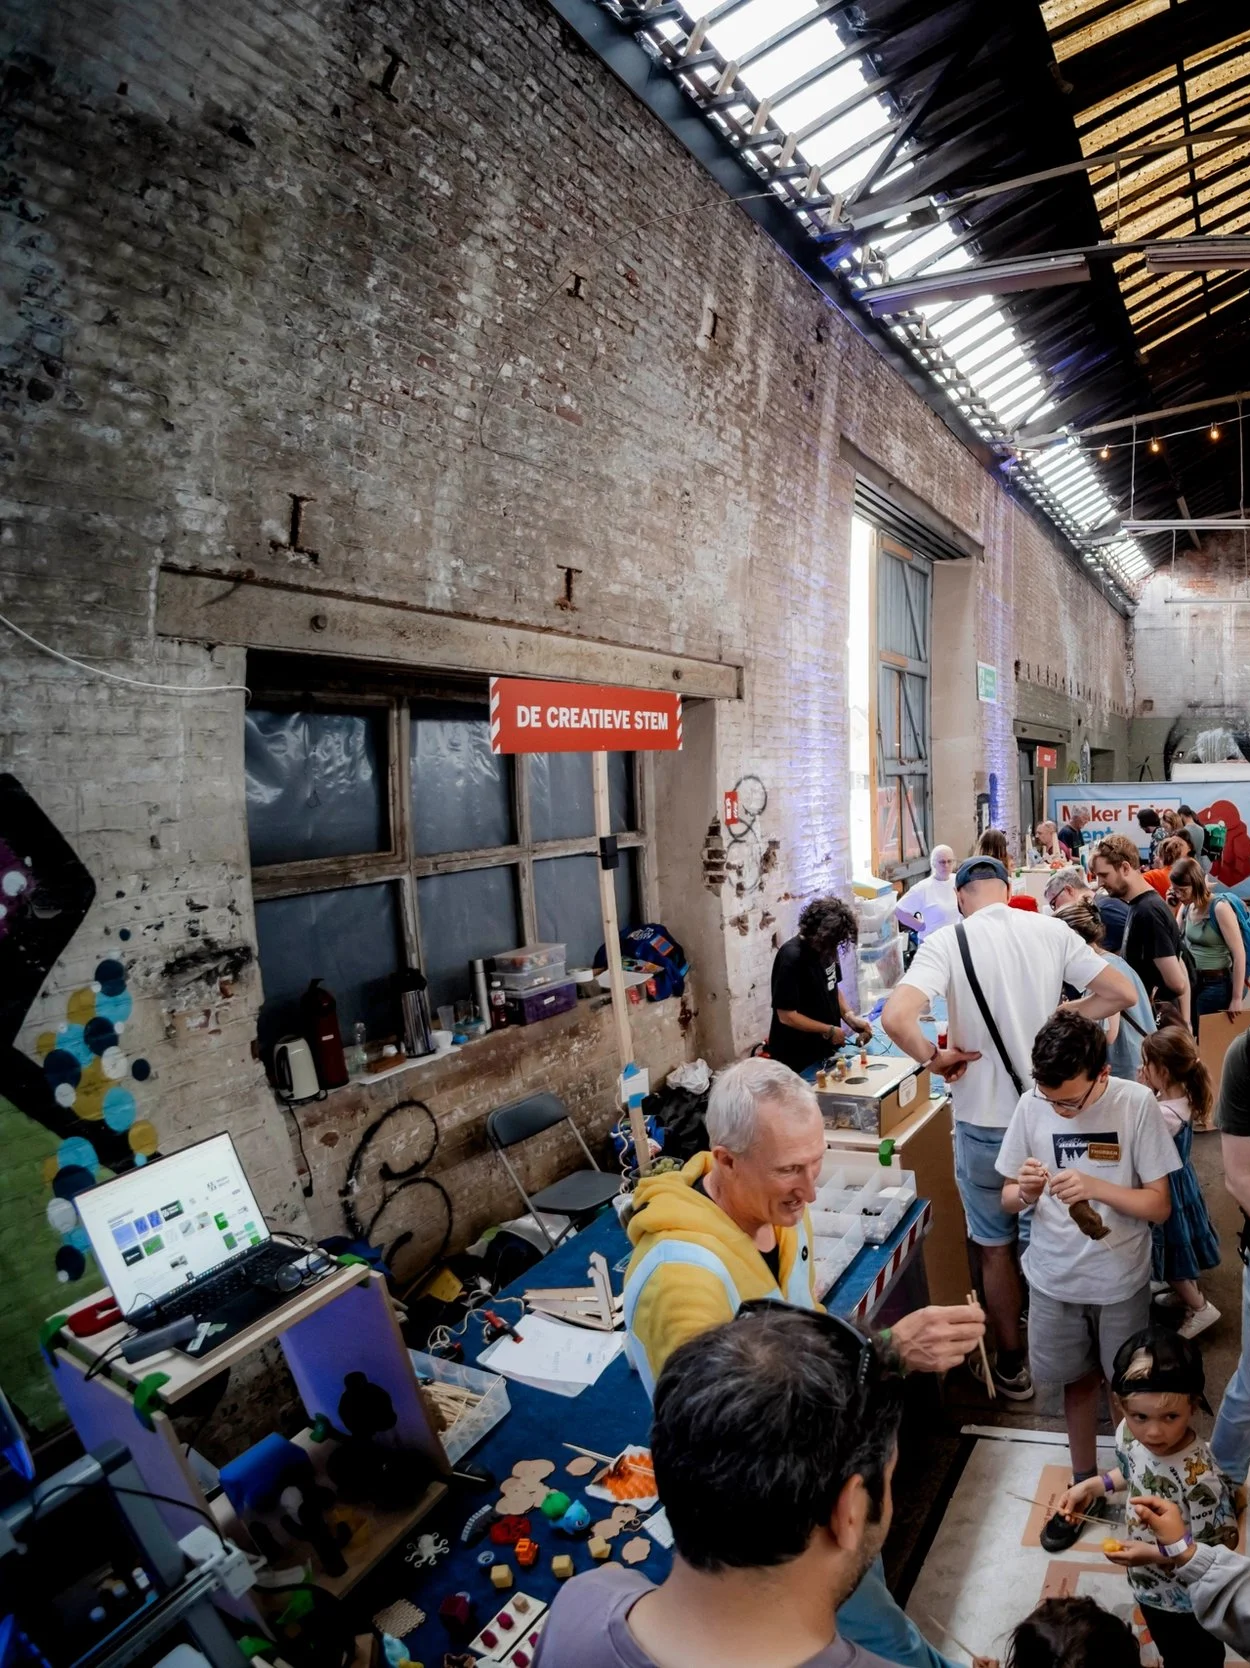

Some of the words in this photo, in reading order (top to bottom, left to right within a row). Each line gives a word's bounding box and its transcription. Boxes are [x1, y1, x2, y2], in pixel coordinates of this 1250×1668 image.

[517, 705, 541, 728] DE
[546, 707, 631, 729] CREATIEVE
[634, 711, 669, 730] STEM
[1062, 805, 1121, 821] Mker
